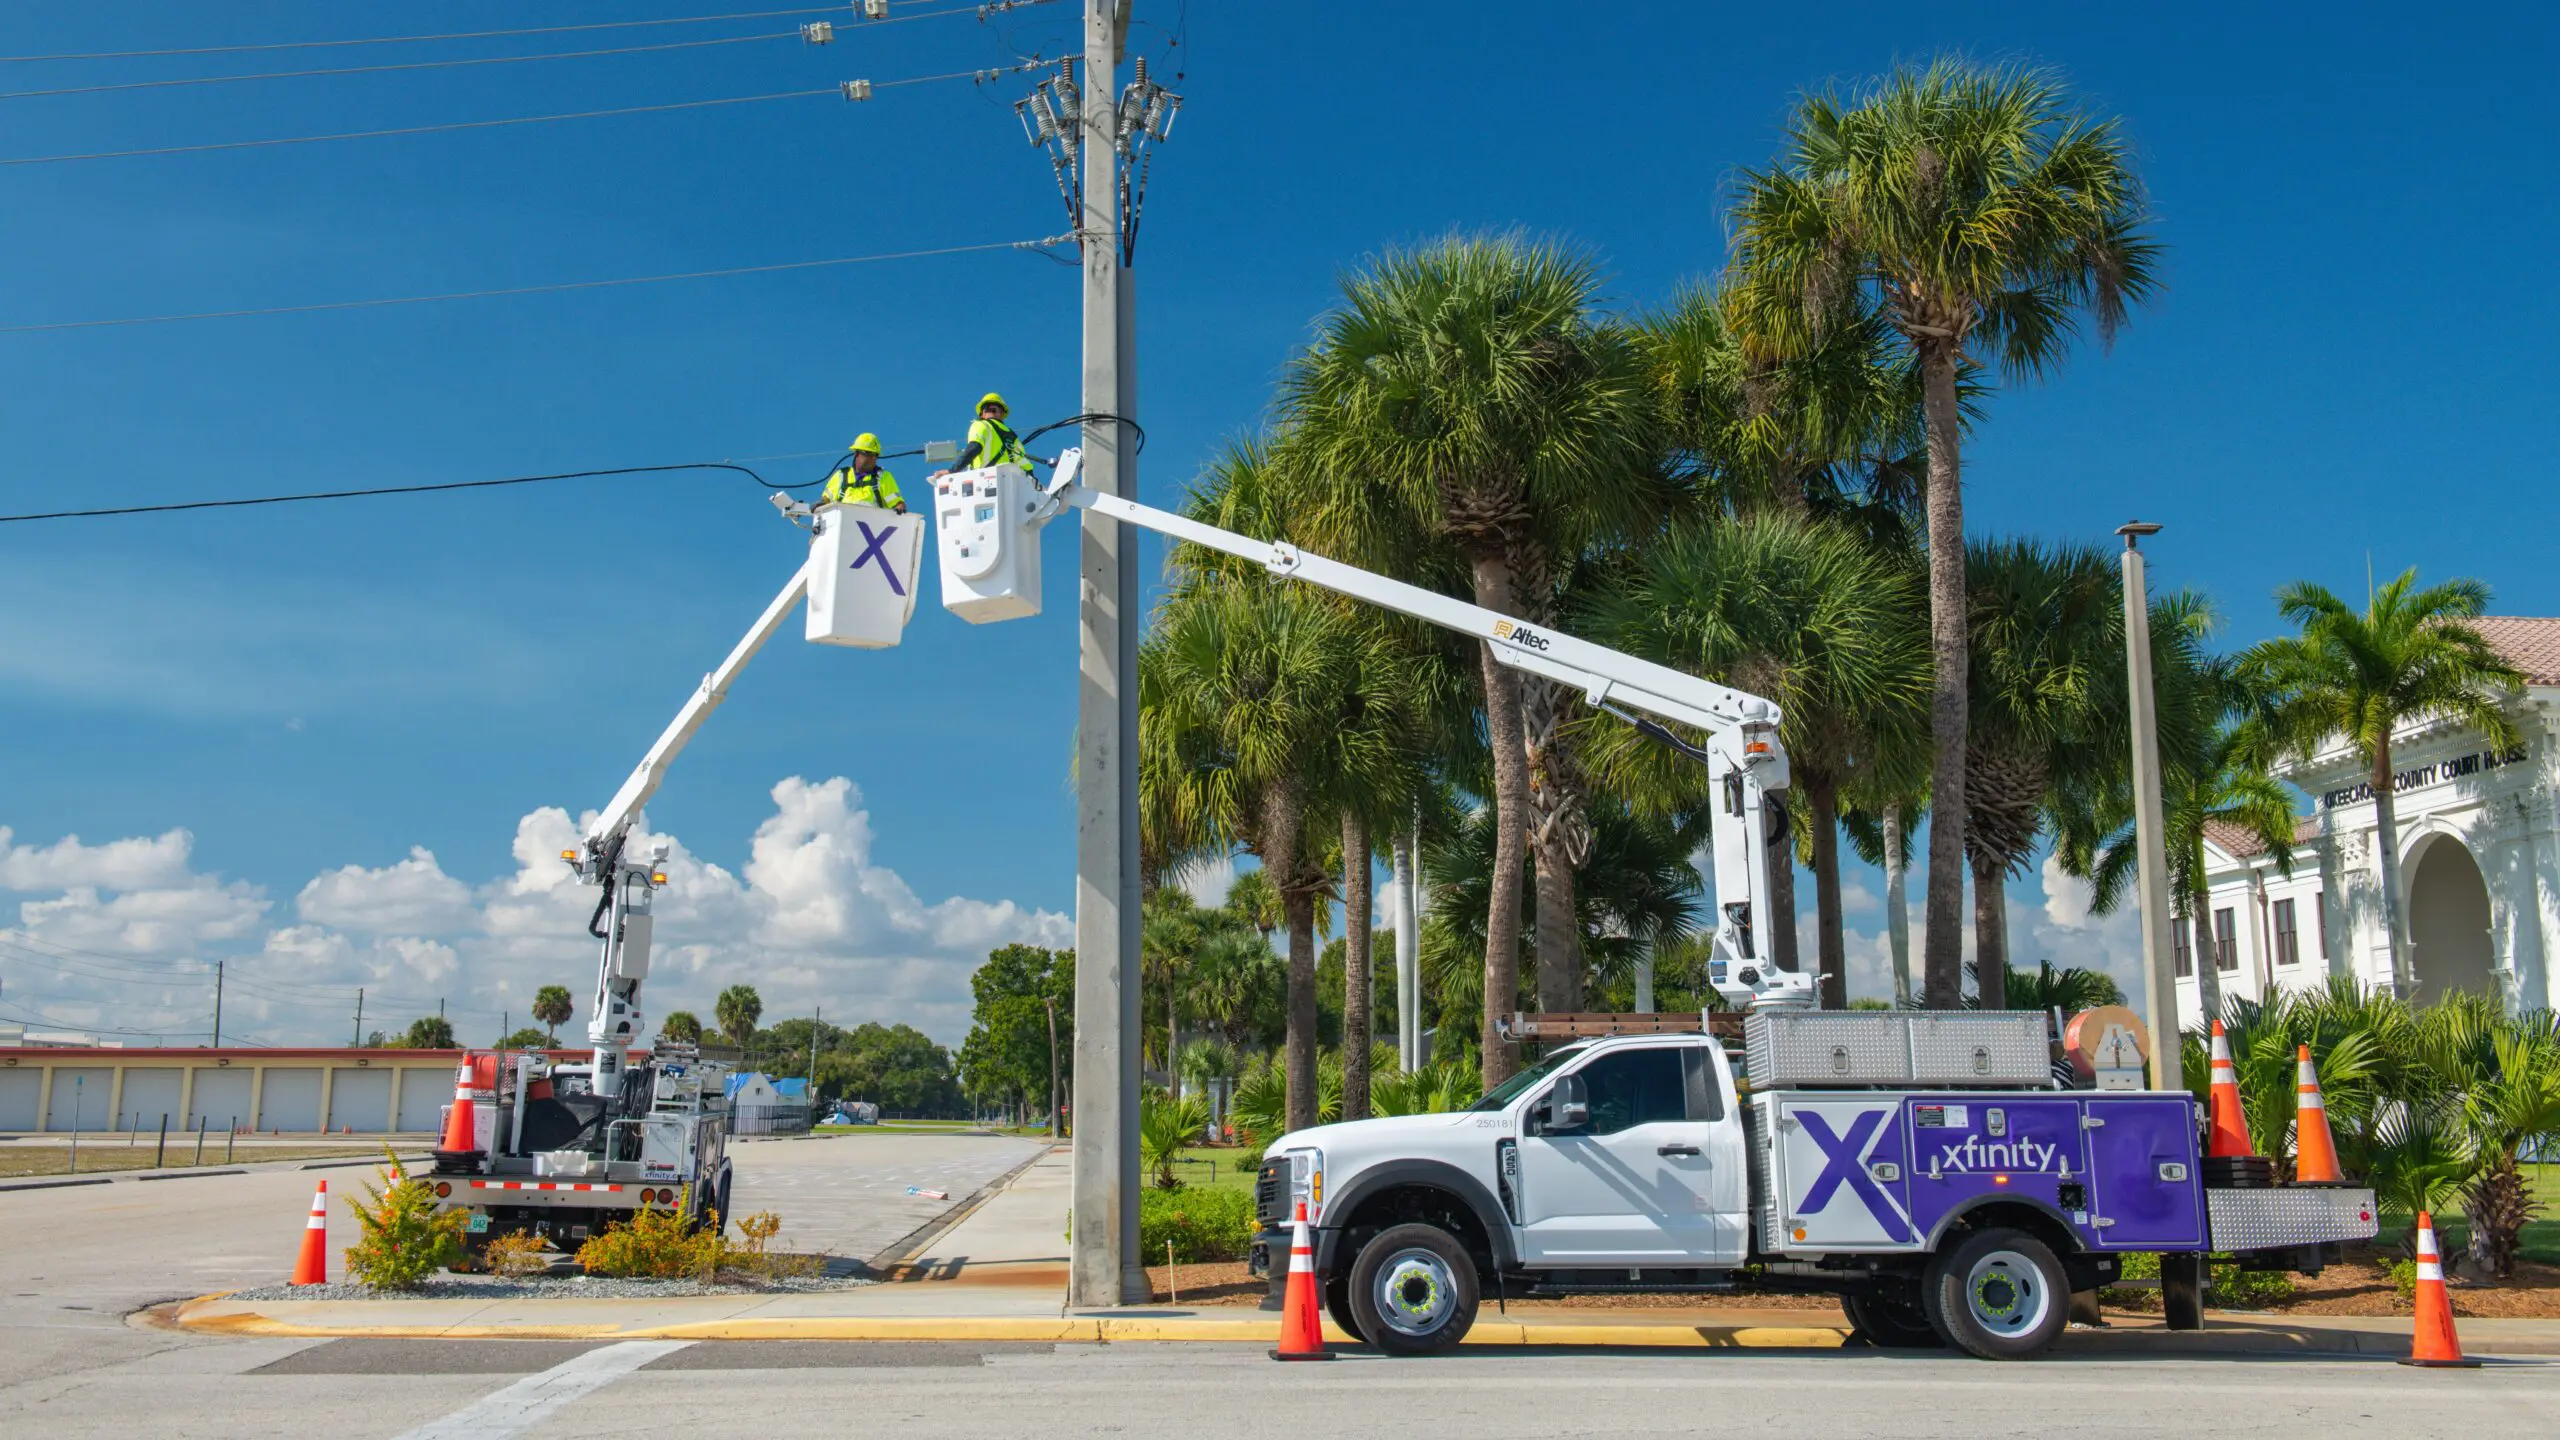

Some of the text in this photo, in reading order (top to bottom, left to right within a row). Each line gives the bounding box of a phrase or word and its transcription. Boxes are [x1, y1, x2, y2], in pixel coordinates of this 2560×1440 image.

[1510, 626, 1550, 651] Altec
[2325, 781, 2376, 809] OKEECHO
[2392, 764, 2437, 793] COUNTY
[2441, 752, 2480, 780] COURT
[1476, 1119, 1513, 1128] 250181
[1941, 1134, 2056, 1172] xfinity
[645, 1171, 689, 1180] xfinity.cm
